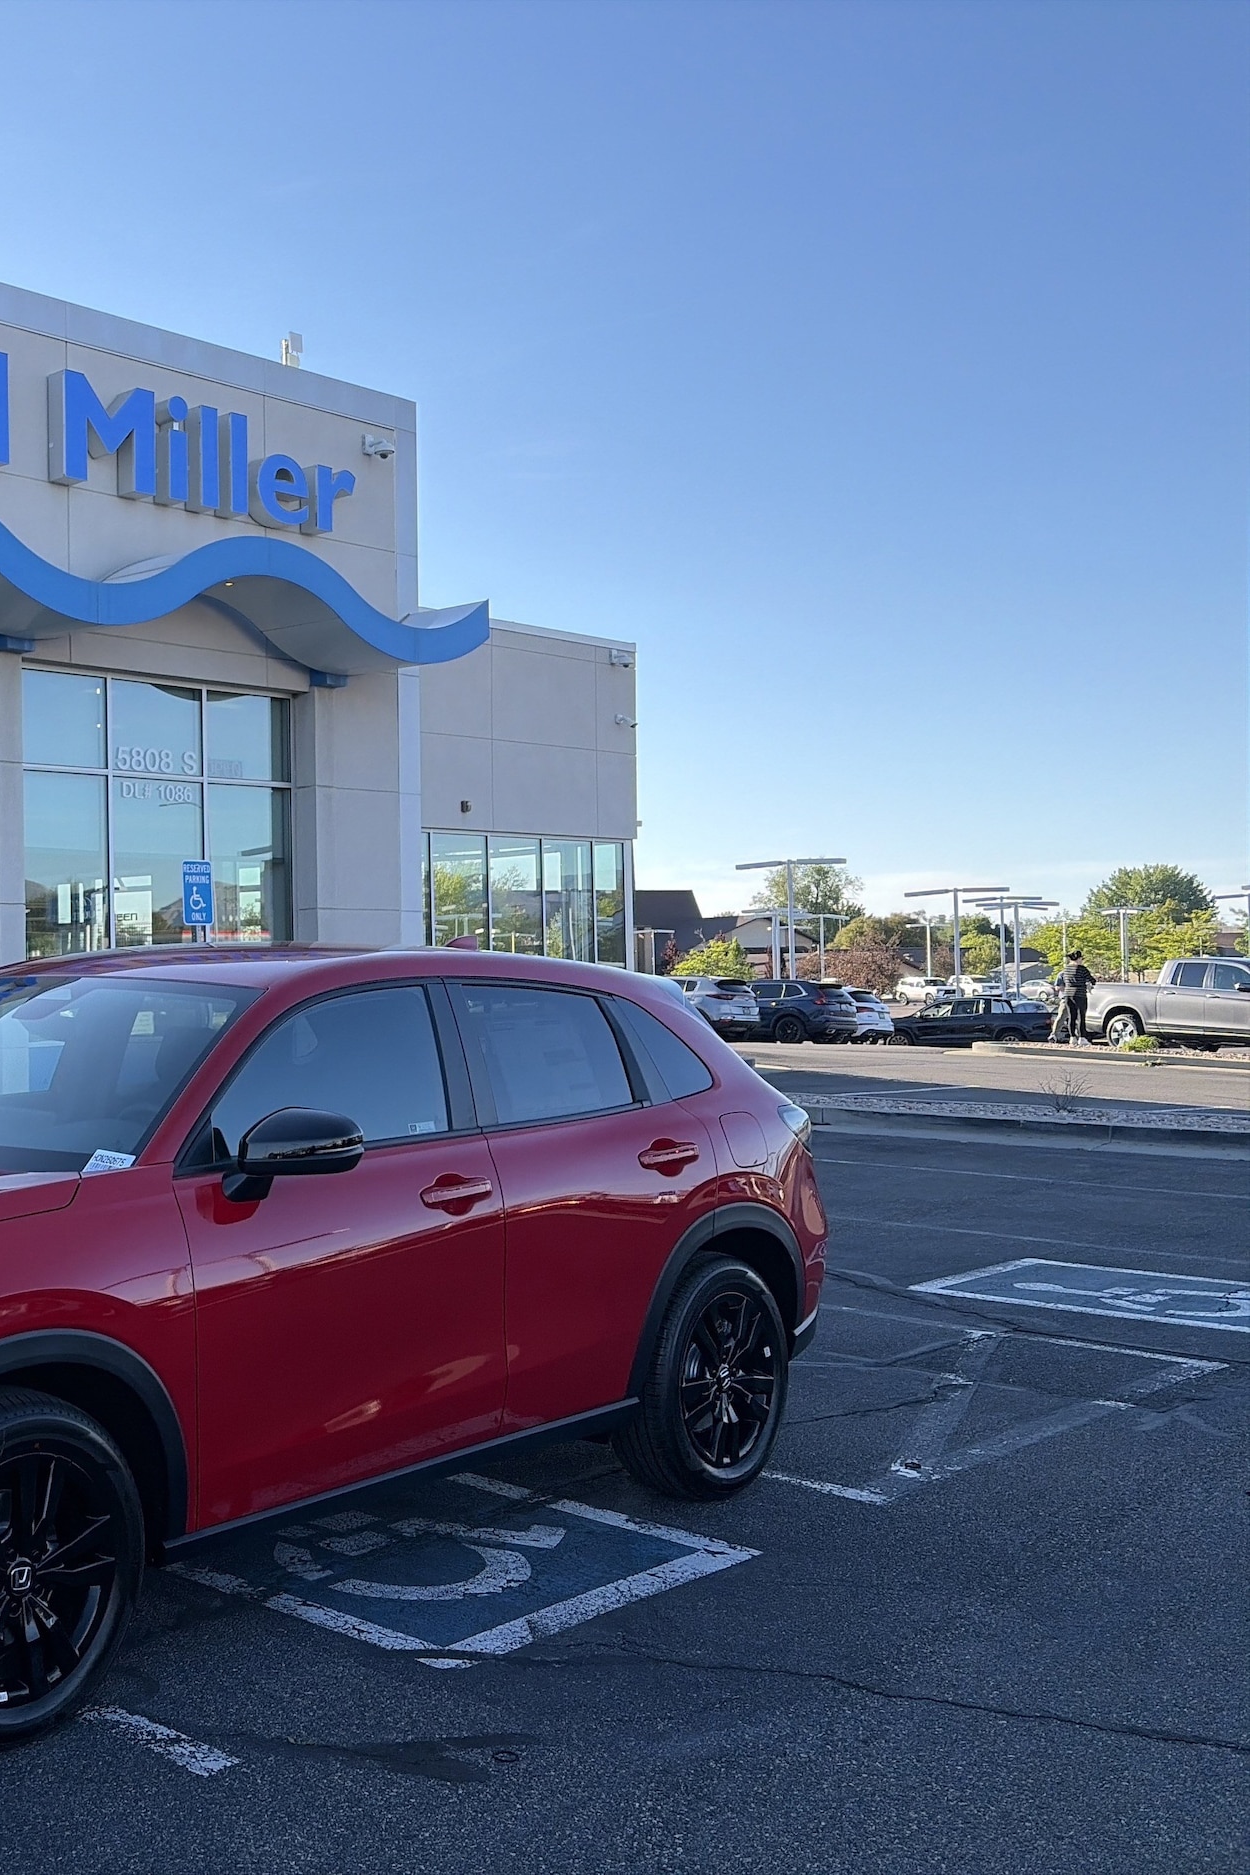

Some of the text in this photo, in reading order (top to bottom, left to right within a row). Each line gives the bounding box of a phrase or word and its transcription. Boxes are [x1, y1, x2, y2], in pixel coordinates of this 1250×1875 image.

[48, 368, 356, 535] Miller
[115, 746, 197, 775] 5808 S
[121, 781, 192, 802] DL# 1086
[183, 863, 210, 873] RESERVED
[184, 874, 210, 884] PARKING
[191, 911, 207, 921] ONLY
